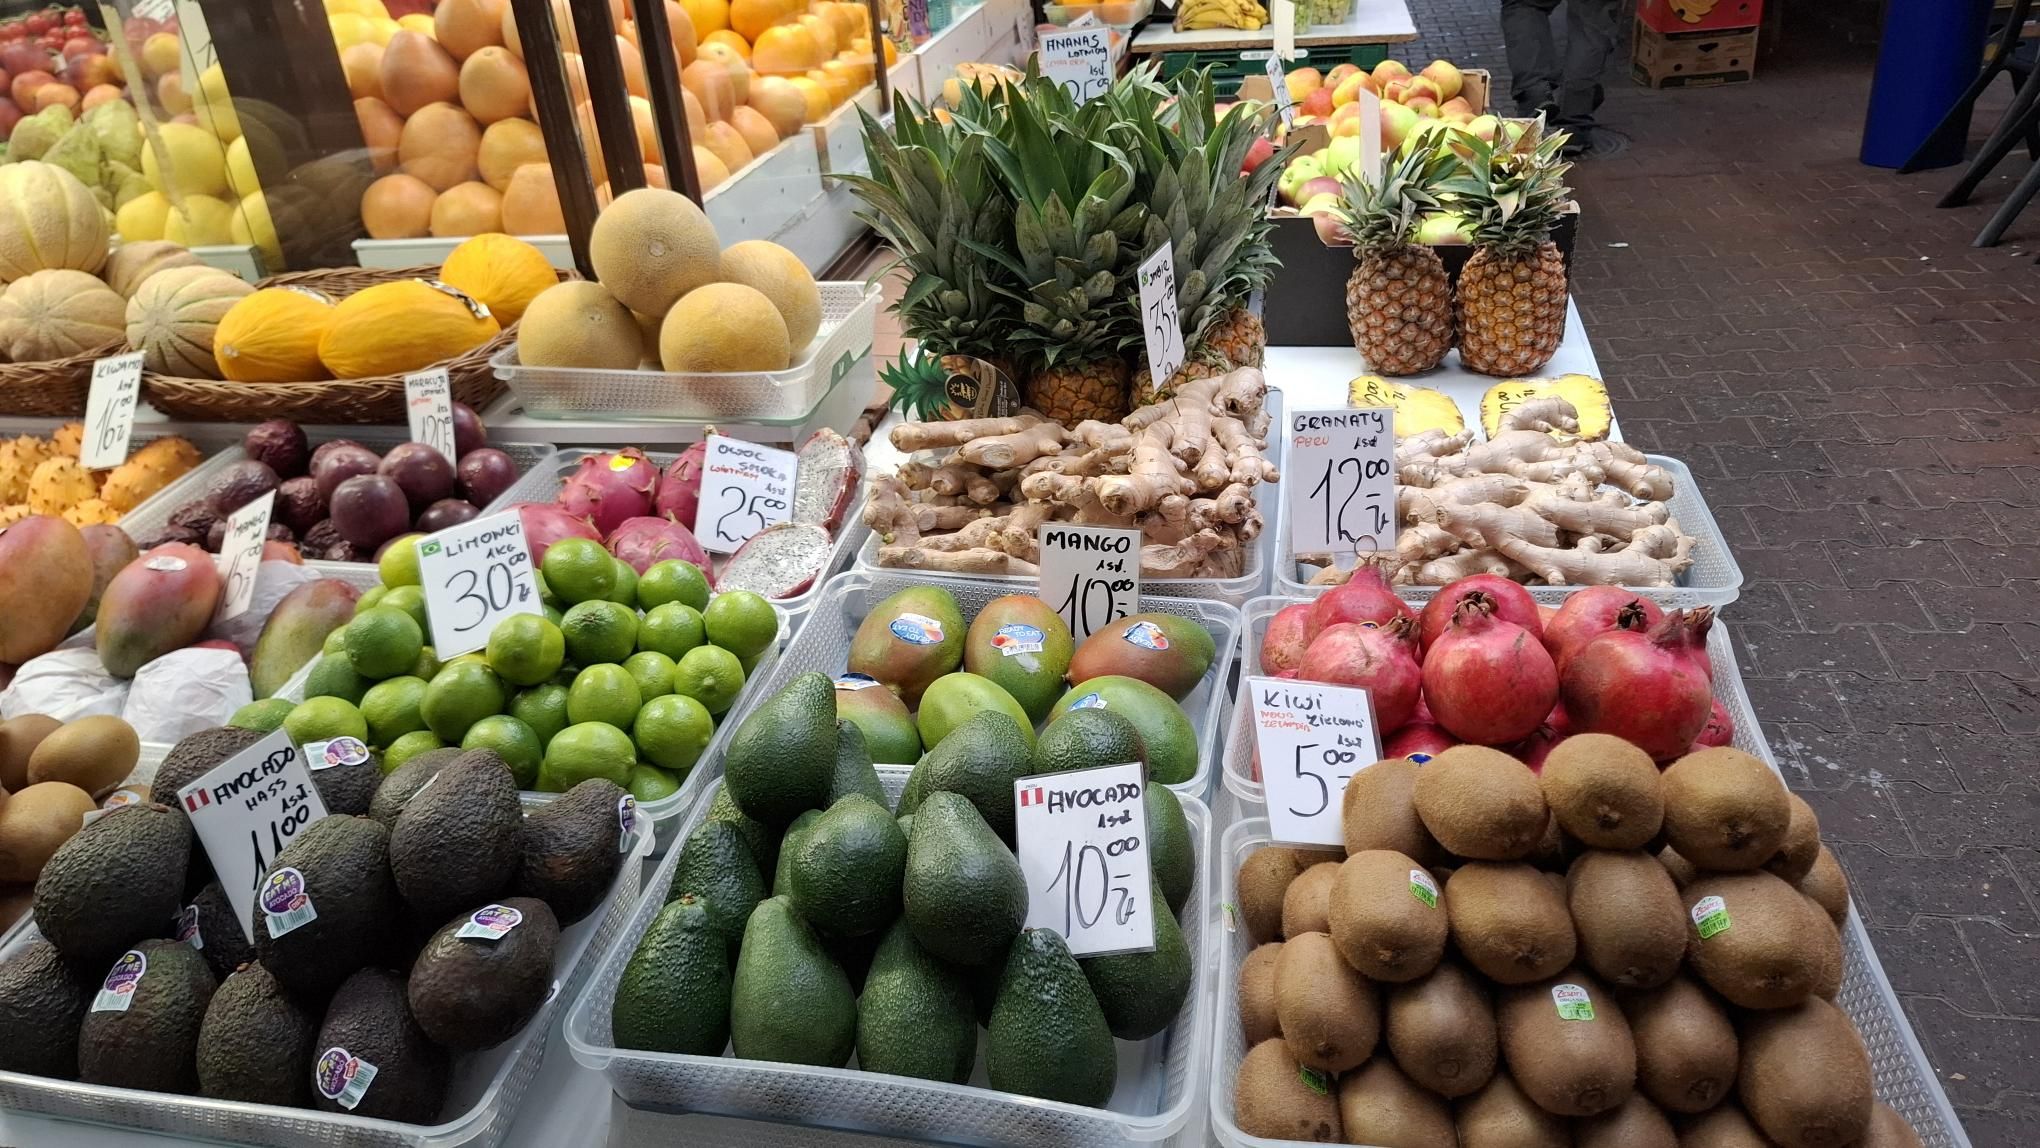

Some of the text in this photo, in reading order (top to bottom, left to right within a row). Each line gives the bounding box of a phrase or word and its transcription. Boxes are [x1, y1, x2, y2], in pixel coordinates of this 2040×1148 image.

[1046, 34, 1100, 52] ANANAS
[1293, 411, 1385, 434] GRANATY
[717, 444, 767, 462] OWOC
[1045, 531, 1131, 554] MANGO
[212, 746, 296, 805] AVOCADO
[245, 777, 288, 811] HASS
[1047, 782, 1141, 815] AVOCADO
[265, 874, 297, 902] EAT ME
[269, 888, 298, 909] AVOCADO
